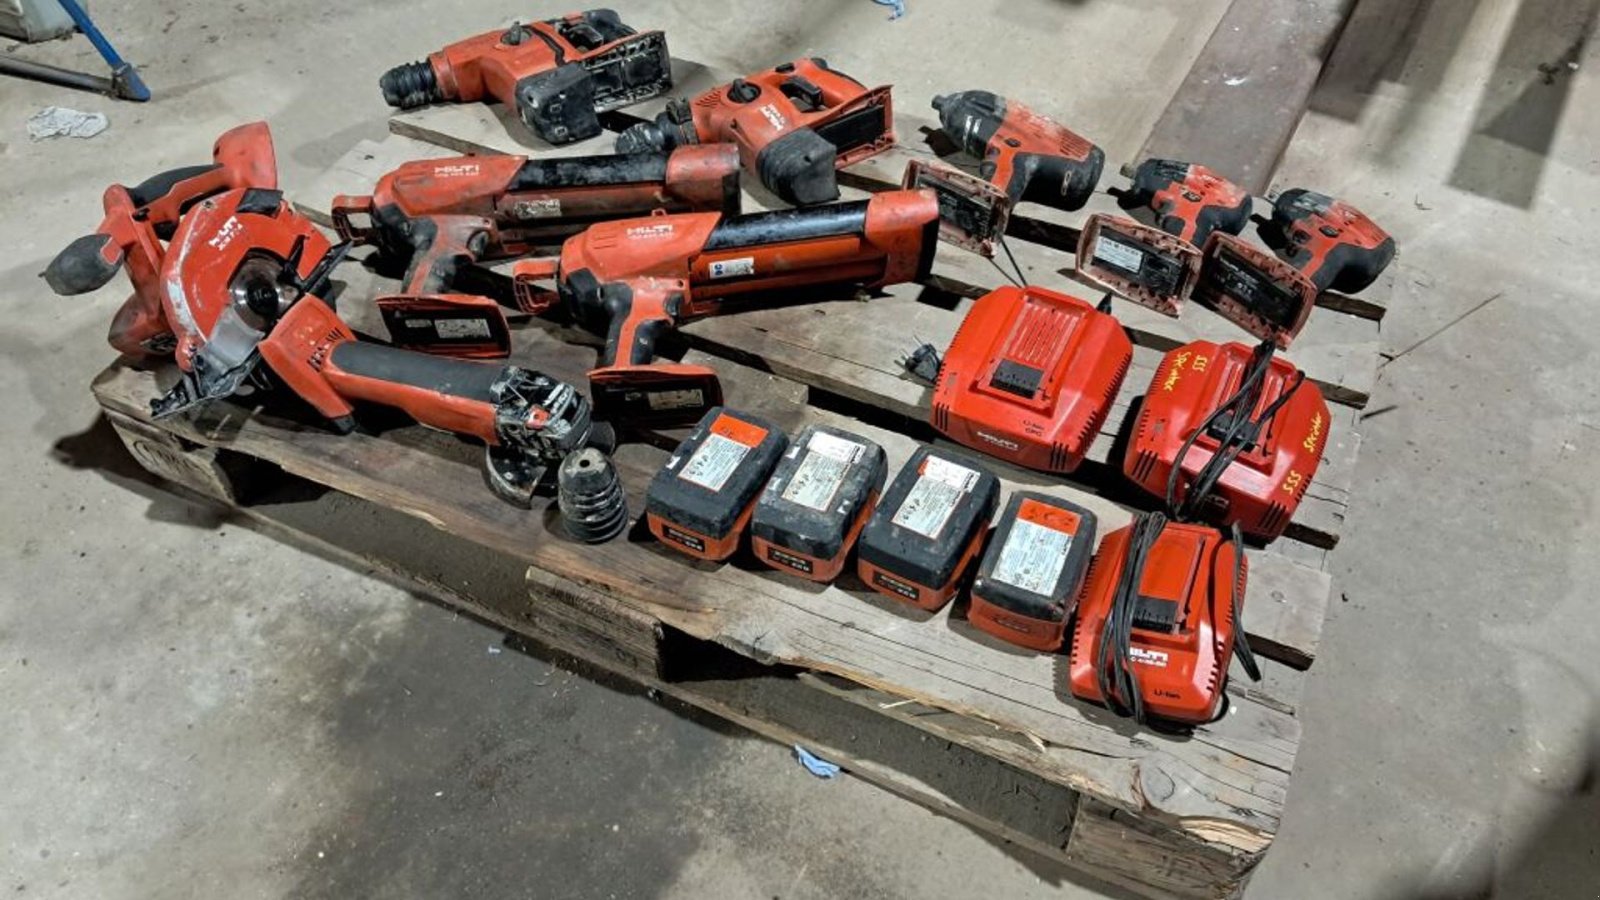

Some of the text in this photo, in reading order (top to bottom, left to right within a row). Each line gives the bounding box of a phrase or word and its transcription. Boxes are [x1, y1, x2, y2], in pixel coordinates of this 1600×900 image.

[434, 165, 480, 174] HILTI
[627, 225, 673, 235] HILTI
[1282, 470, 1301, 495] SSS
